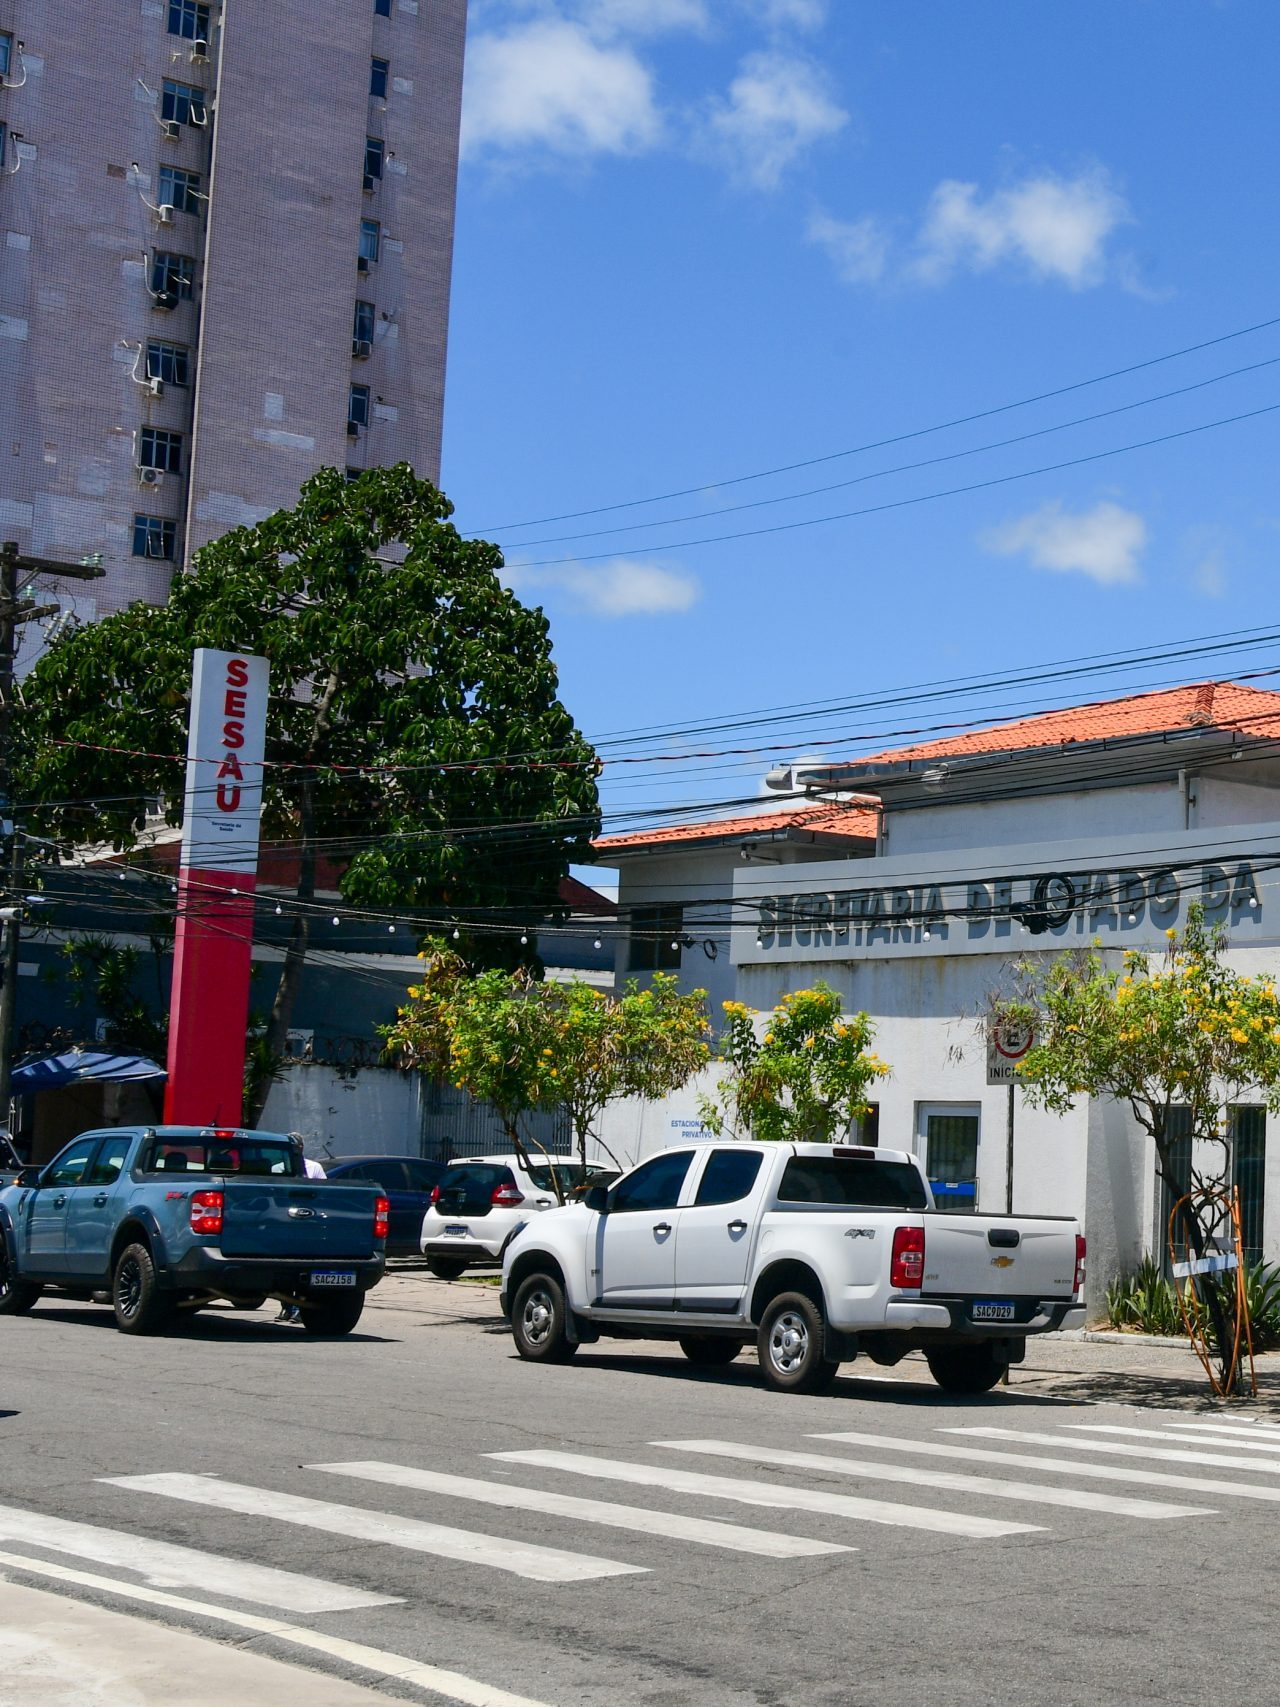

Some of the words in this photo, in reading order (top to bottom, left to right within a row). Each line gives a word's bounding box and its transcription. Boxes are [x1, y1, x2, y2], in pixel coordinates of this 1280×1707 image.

[216, 659, 249, 813] SESAU
[967, 880, 1012, 923] DE
[1201, 862, 1262, 909] DA
[976, 1306, 1012, 1318] SAC9D29
